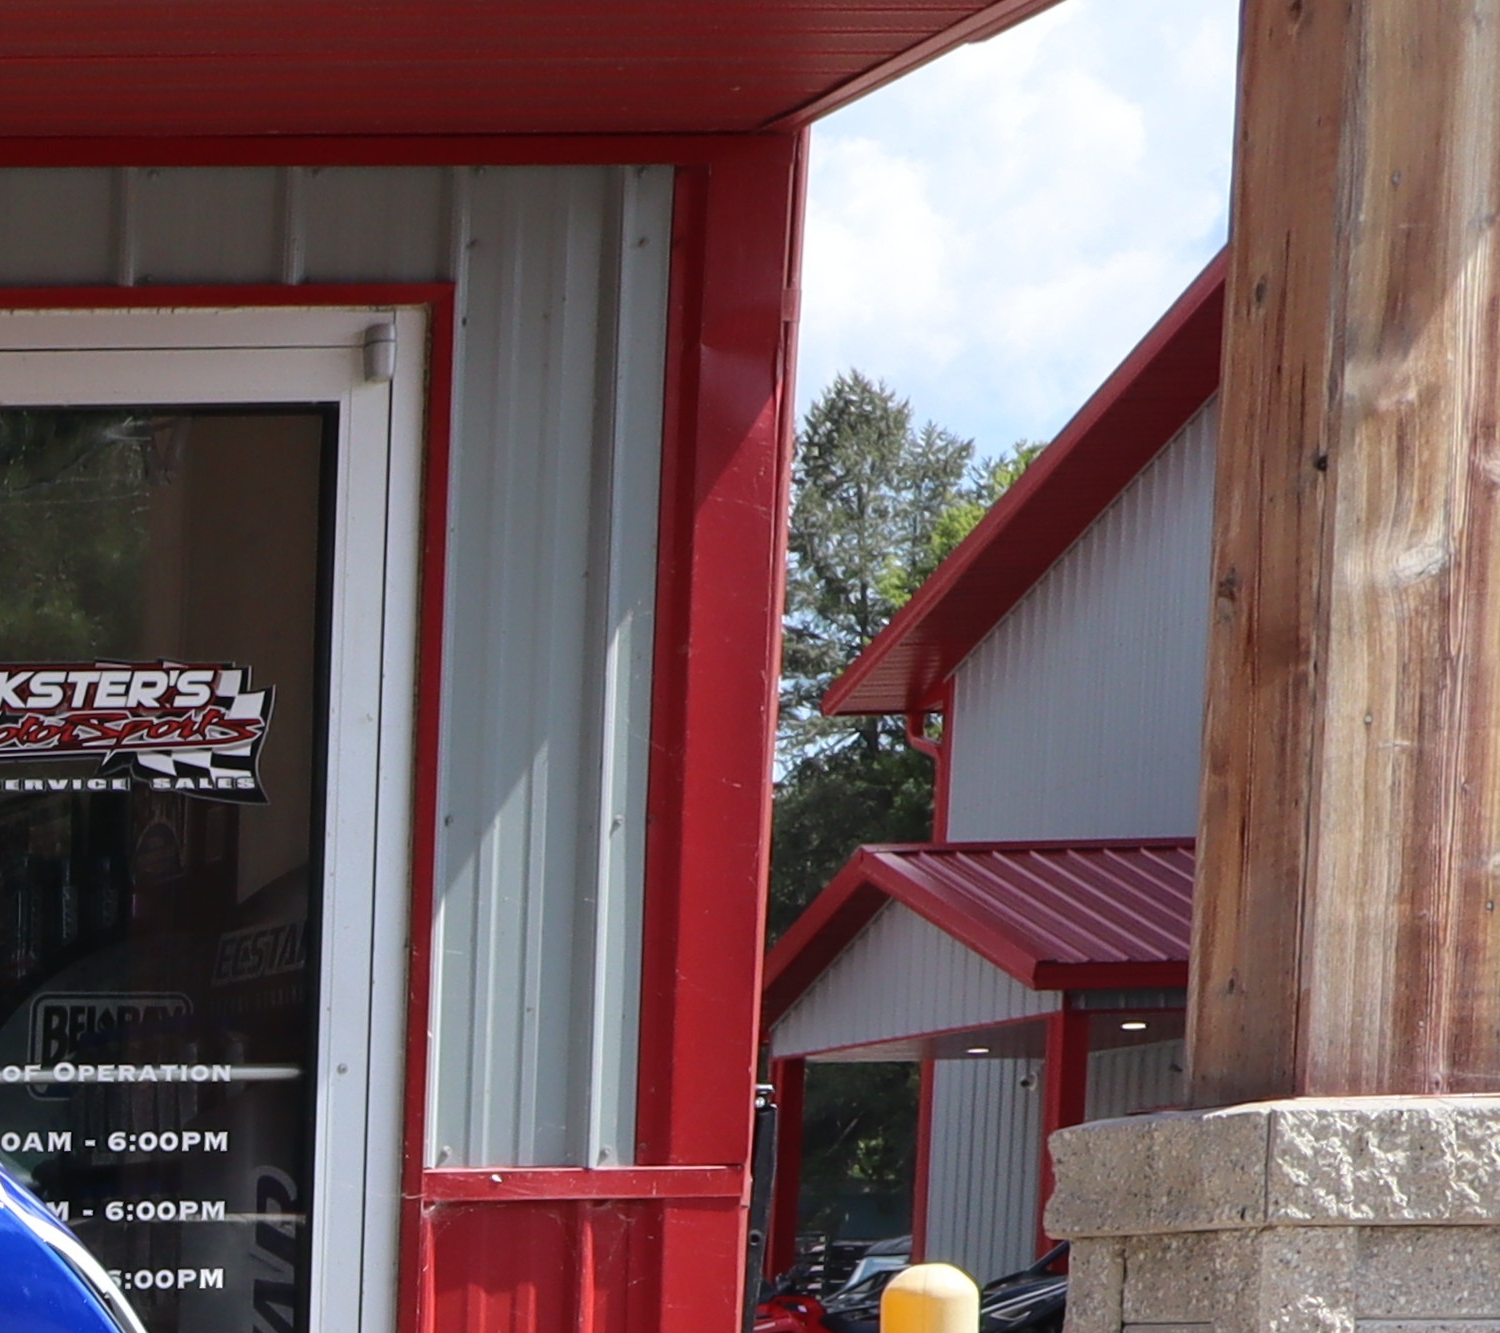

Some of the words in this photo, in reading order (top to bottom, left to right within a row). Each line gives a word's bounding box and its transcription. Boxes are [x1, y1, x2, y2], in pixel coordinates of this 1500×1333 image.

[151, 776, 257, 791] SALES
[2, 1064, 42, 1083] OF
[107, 1131, 229, 1153] 6:00PM
[105, 1200, 226, 1222] 6:00PM
